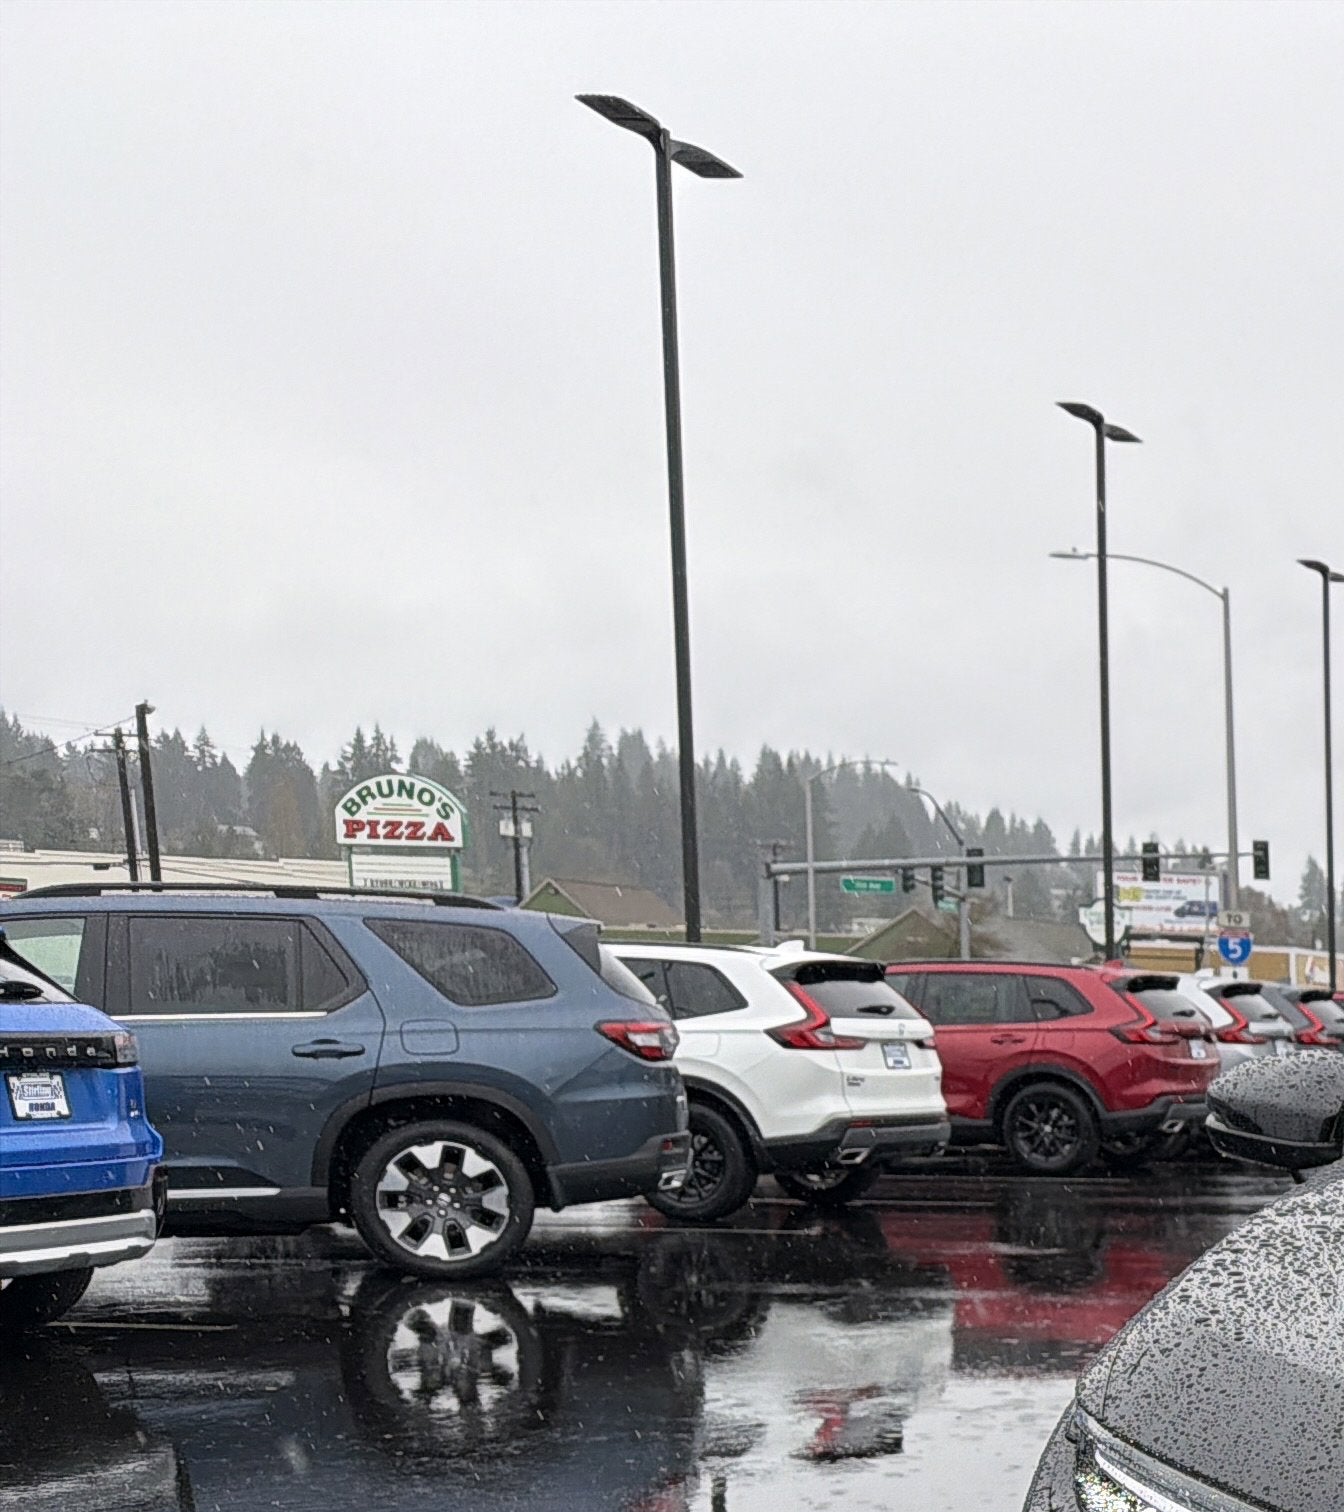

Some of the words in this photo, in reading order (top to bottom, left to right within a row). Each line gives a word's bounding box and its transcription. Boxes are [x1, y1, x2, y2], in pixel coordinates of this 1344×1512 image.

[341, 778, 455, 821] BRUNO'S
[343, 818, 455, 842] PIZZA
[1227, 912, 1243, 924] TO
[1228, 938, 1242, 959] 5
